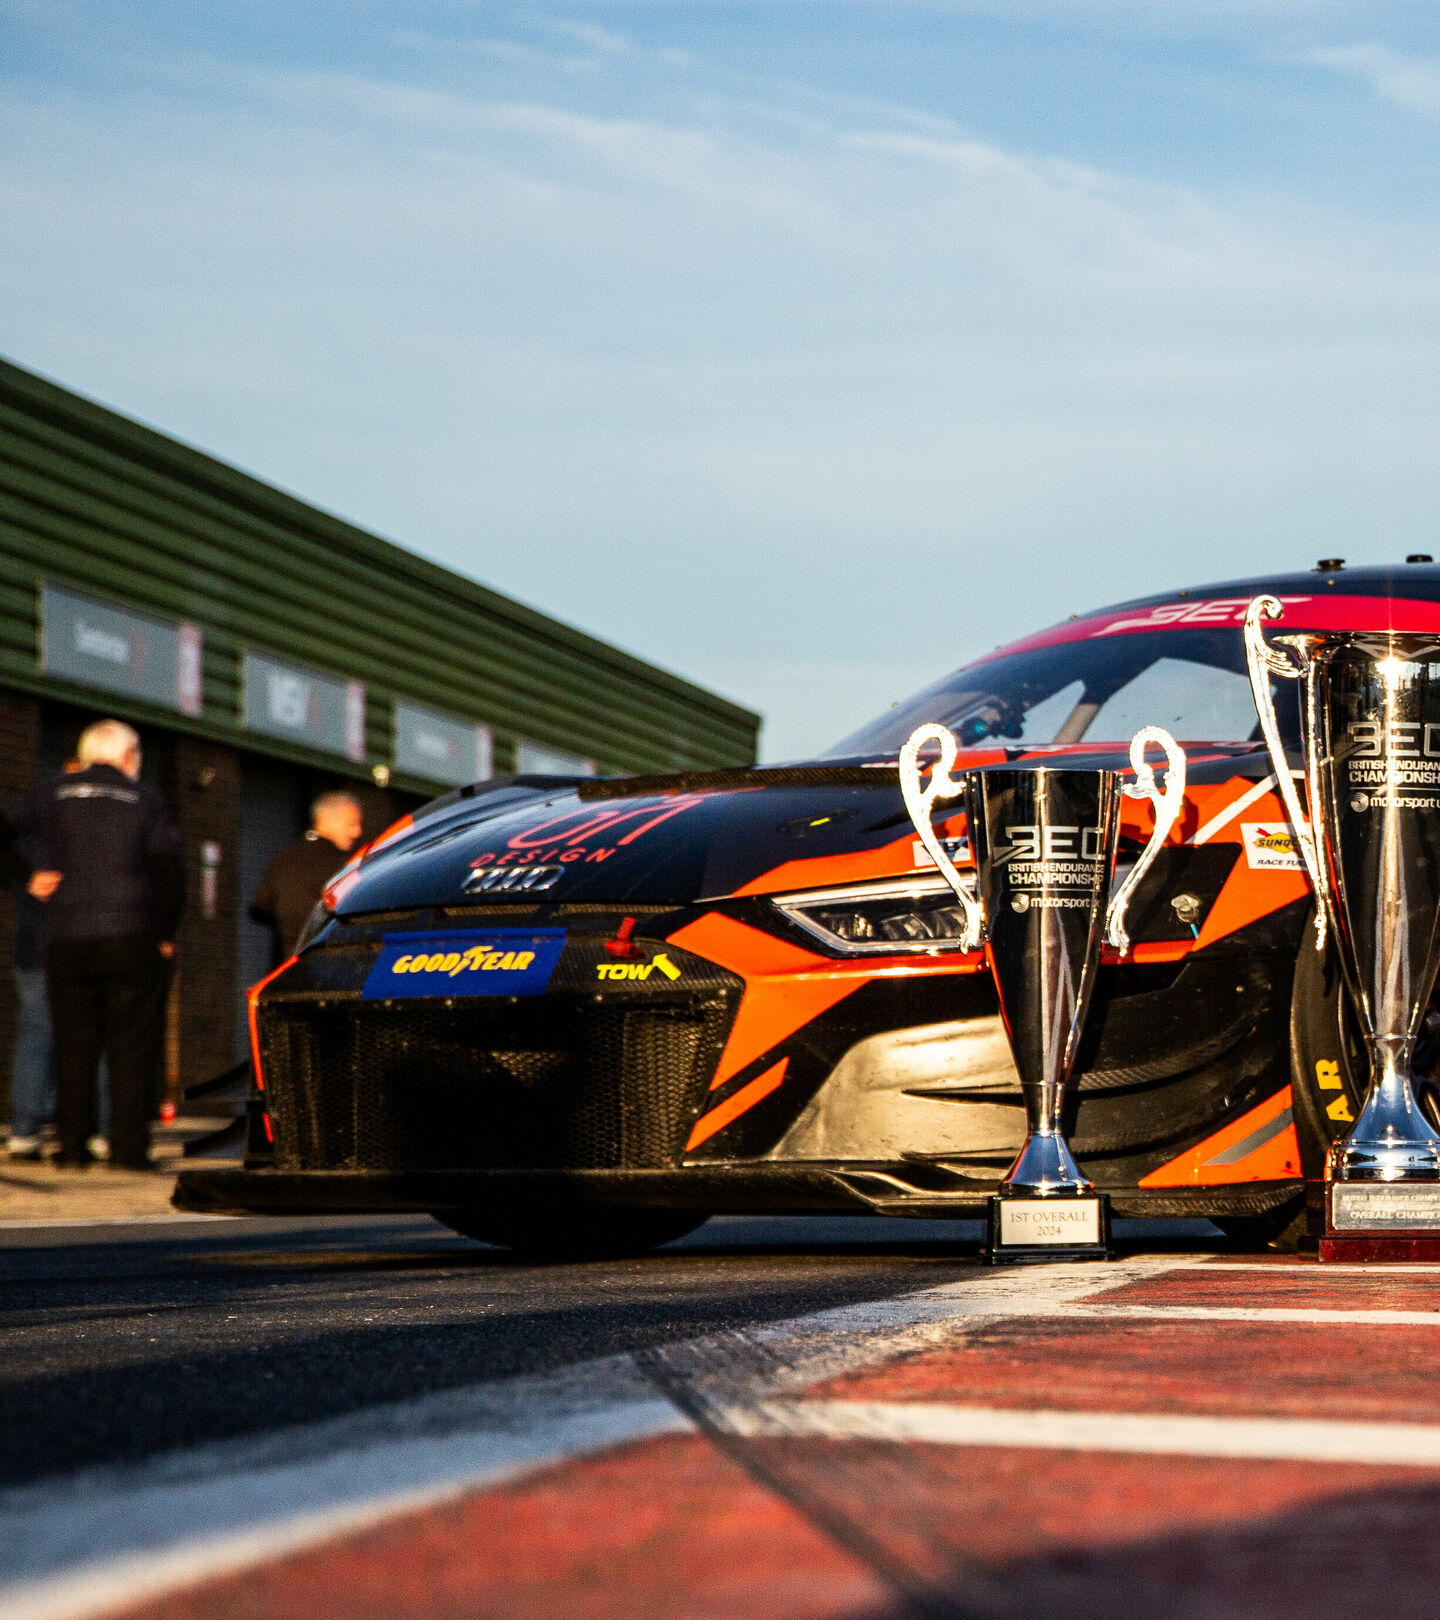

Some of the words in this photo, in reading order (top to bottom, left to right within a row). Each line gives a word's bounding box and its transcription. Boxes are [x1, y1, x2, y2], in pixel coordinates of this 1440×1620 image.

[1348, 760, 1387, 770] BRITISH
[1370, 795, 1435, 809] motorsport
[469, 847, 617, 868] DESIGN
[1008, 863, 1049, 873] BRITISH
[1049, 863, 1105, 874] ENDURANCE
[1009, 872, 1104, 885] CHAMPIONSHIP
[1030, 897, 1090, 909] motorsport
[392, 945, 536, 978] GOODYEAR
[596, 963, 653, 981] TOW
[1010, 1212, 1030, 1223] 1ST
[1032, 1211, 1089, 1223] OVERALL
[1349, 1211, 1394, 1220] OVERALL
[1036, 1225, 1062, 1237] 2024
